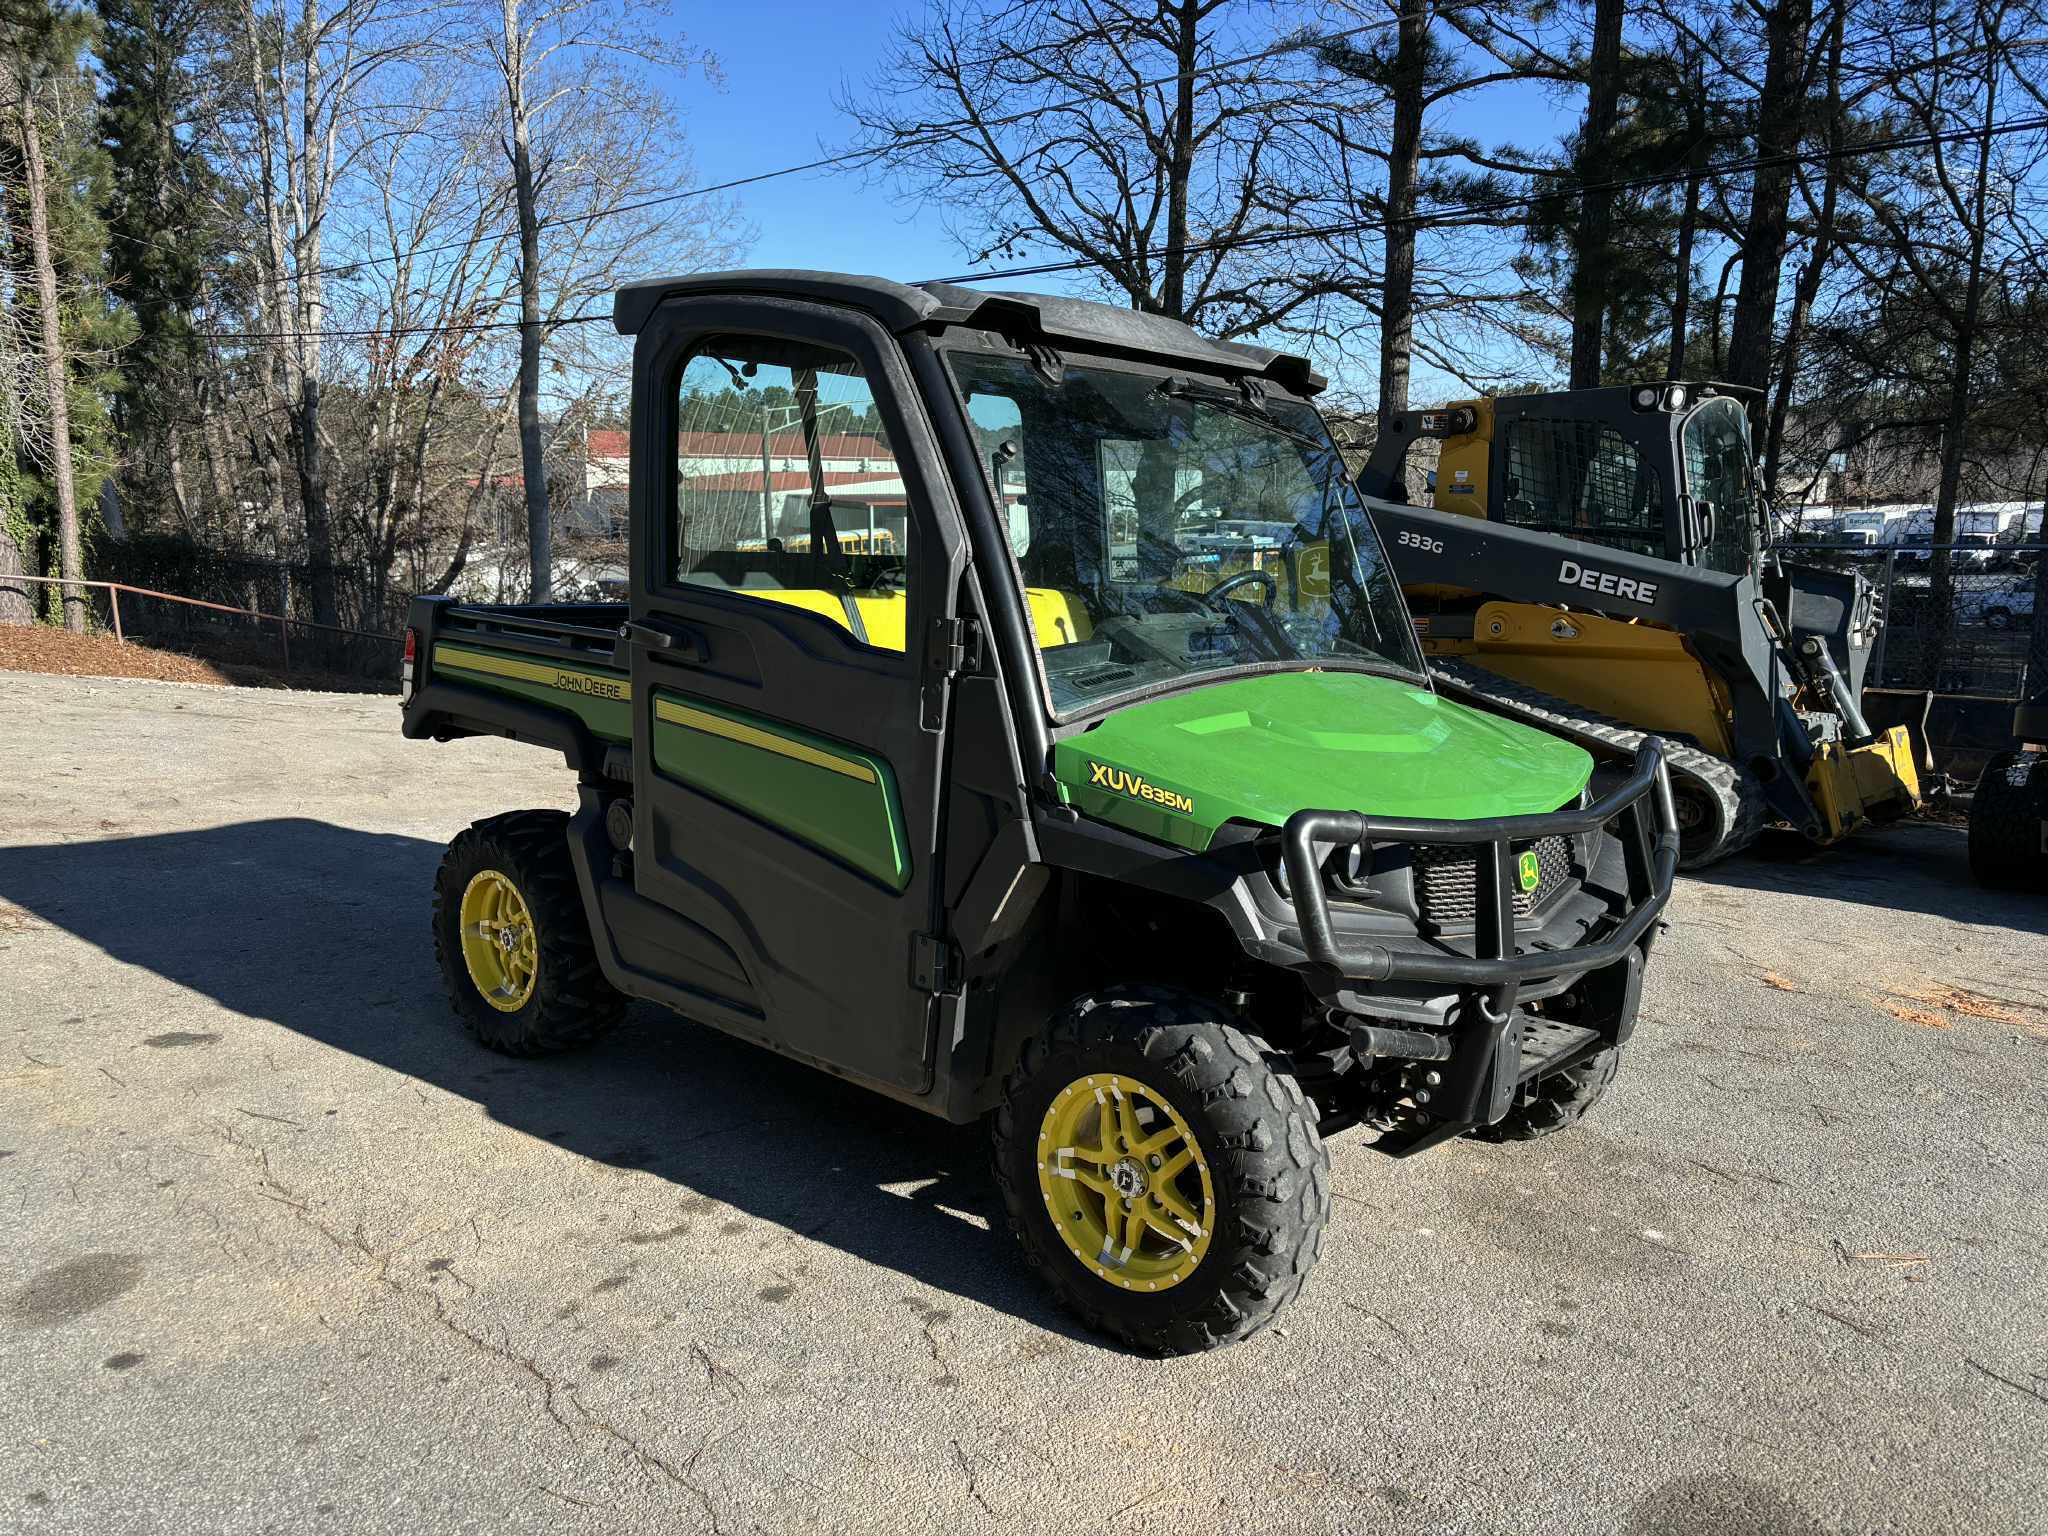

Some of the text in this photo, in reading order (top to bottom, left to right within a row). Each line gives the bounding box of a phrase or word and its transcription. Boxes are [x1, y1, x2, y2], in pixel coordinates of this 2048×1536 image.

[1397, 531, 1444, 554] 333G
[1558, 560, 1657, 604] DEERE
[553, 671, 621, 698] JOHN DEERE
[1088, 760, 1194, 813] XUV835M
